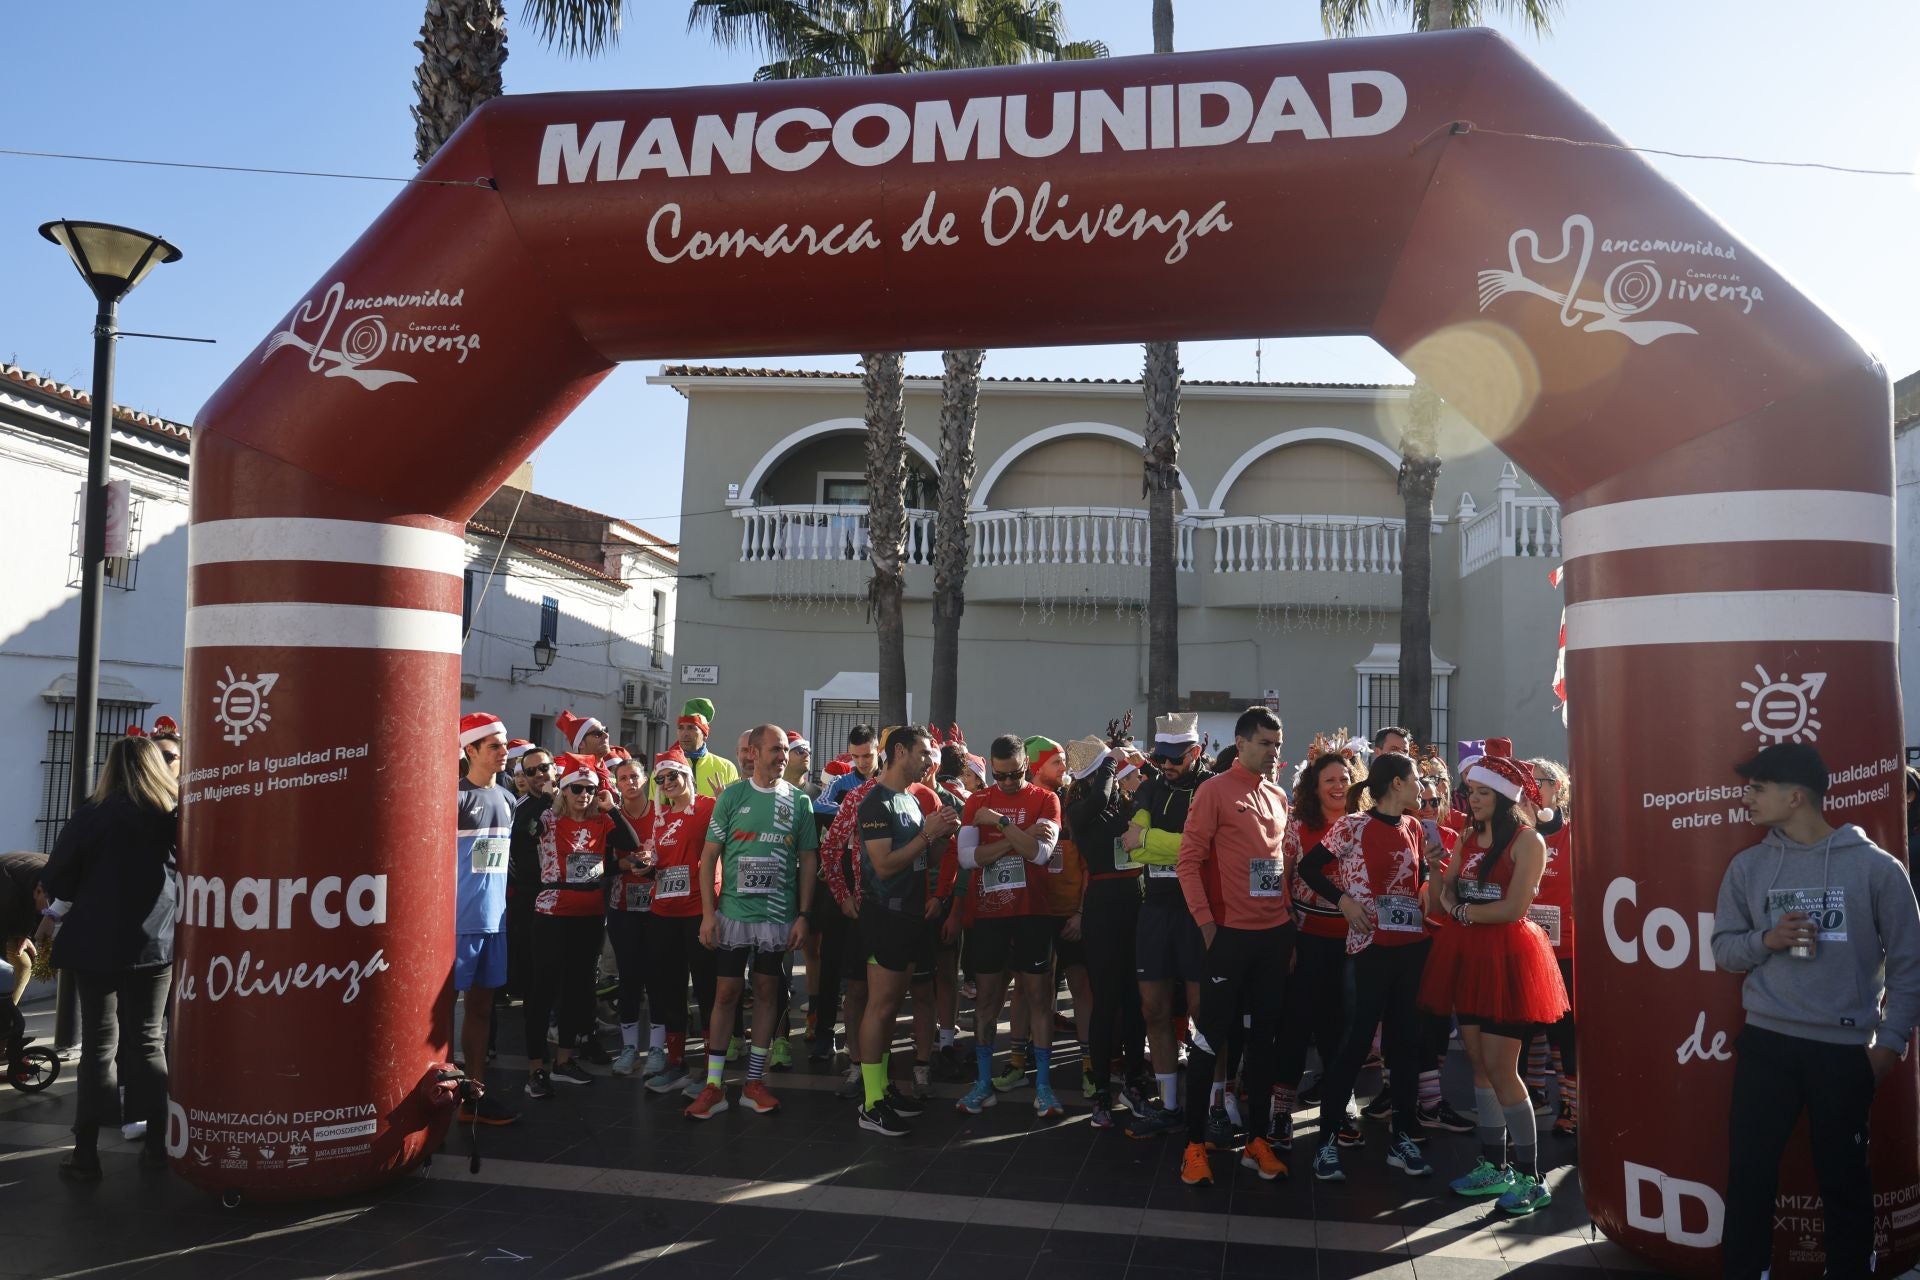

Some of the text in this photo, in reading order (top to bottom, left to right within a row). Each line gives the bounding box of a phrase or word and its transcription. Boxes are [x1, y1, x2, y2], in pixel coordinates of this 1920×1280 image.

[537, 70, 1408, 185] MANCOMUNIDAD
[646, 182, 1234, 265] Comarca de Olivenza
[222, 763, 245, 780] por
[248, 759, 260, 772] la
[264, 748, 331, 773] Igualdad
[335, 743, 369, 760] Real
[1880, 754, 1898, 772] Real
[204, 784, 251, 802] Mujeres
[254, 782, 264, 796] y
[268, 767, 348, 791] Hombres!!
[1671, 812, 1723, 830] entre
[663, 879, 686, 893] 119
[744, 874, 772, 888] 34
[998, 869, 1012, 884] 6
[1260, 874, 1281, 891] 82
[174, 870, 388, 931] omarca
[1801, 896, 1844, 904] SILVETRE
[1390, 909, 1413, 926] 81
[175, 948, 390, 1003] de Olivenza
[1676, 1010, 1732, 1065] de
[190, 1103, 377, 1126] DINAMIZACIÓN DEPORTIVA
[190, 1122, 376, 1145] DE EXTREMADURA #SOMOSDEPORTE
[1623, 1160, 1726, 1248] DD
